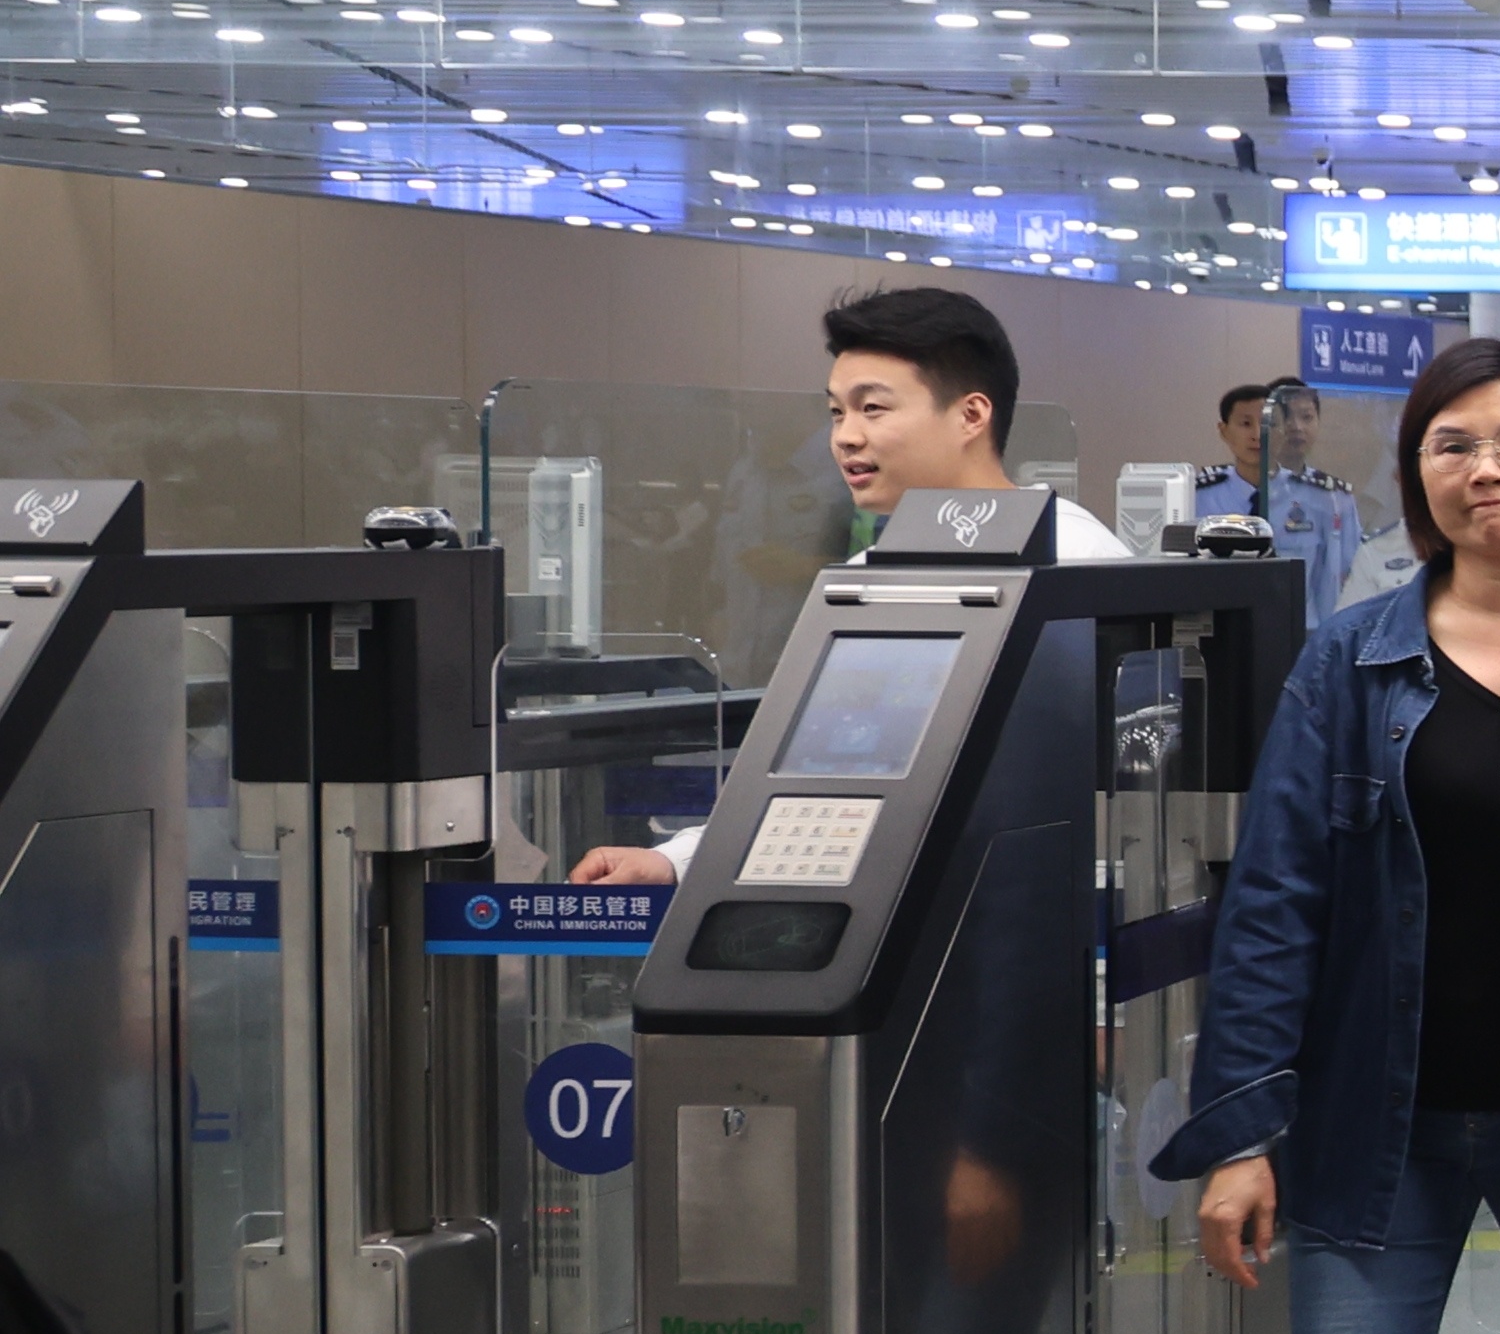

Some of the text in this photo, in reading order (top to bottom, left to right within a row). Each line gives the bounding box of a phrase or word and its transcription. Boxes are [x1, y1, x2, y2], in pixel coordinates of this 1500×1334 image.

[189, 891, 256, 911] 民管理
[509, 895, 651, 916] 中国移民管理
[514, 920, 647, 930] CHINA IMMIGRATION
[548, 1079, 633, 1138] 07
